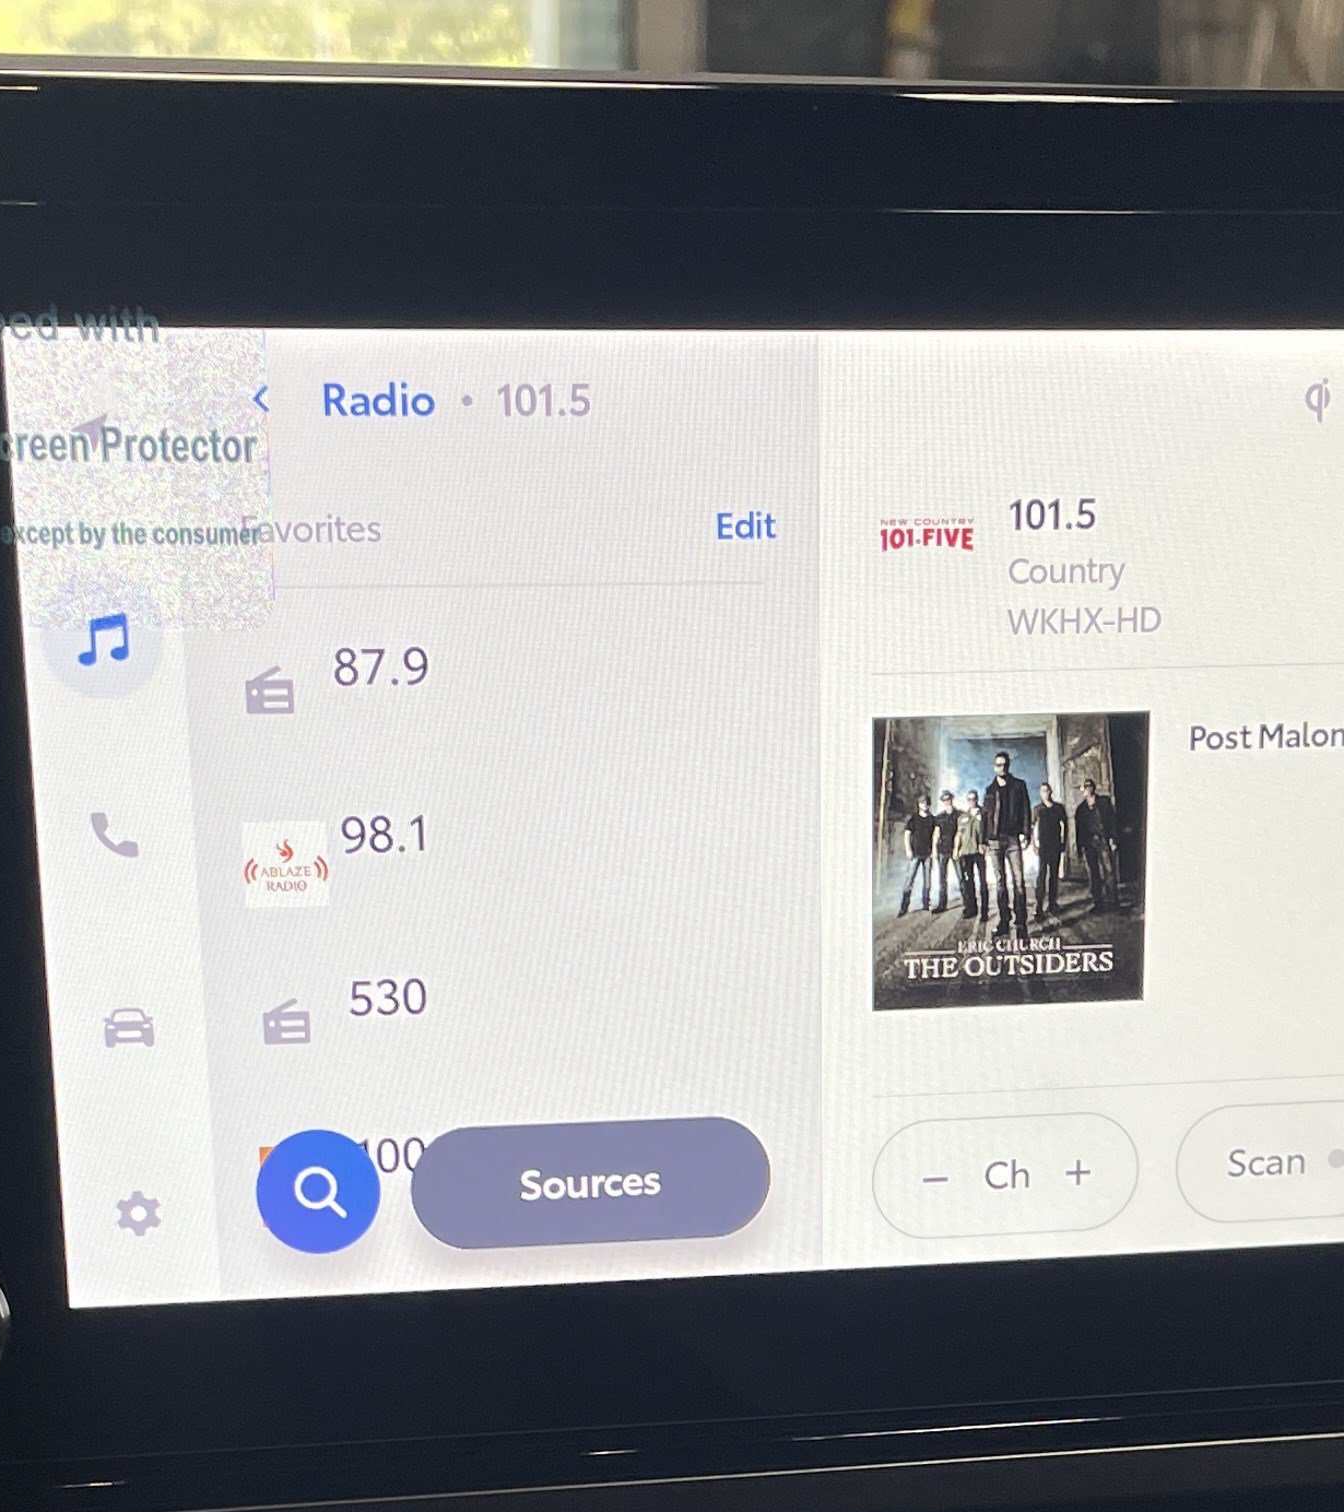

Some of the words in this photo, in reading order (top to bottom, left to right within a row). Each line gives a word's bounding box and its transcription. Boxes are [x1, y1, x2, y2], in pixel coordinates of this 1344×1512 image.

[74, 305, 160, 344] with
[323, 382, 436, 417] Radio
[497, 383, 591, 417] 101.5
[101, 427, 258, 463] Protector
[241, 513, 382, 544] Favorites
[716, 511, 777, 541] Edit
[1009, 498, 1096, 531] 101.5
[1, 524, 72, 550] except
[78, 522, 107, 549] by
[112, 522, 147, 545] the
[152, 525, 260, 546] consumer
[1008, 557, 1126, 591] Country
[1006, 606, 1162, 635] WKHX-HD
[333, 646, 430, 686] 87.9
[1190, 724, 1252, 752] Post
[340, 814, 426, 854] 98.1
[261, 865, 311, 878] ABLAZE
[266, 880, 307, 892] RADIO
[904, 956, 958, 980] THE
[964, 951, 1114, 977] OUTSIDERS
[349, 977, 427, 1016] 530
[984, 1158, 1031, 1191] Ch
[1227, 1148, 1307, 1178] Scan
[519, 1168, 662, 1202] Sources
